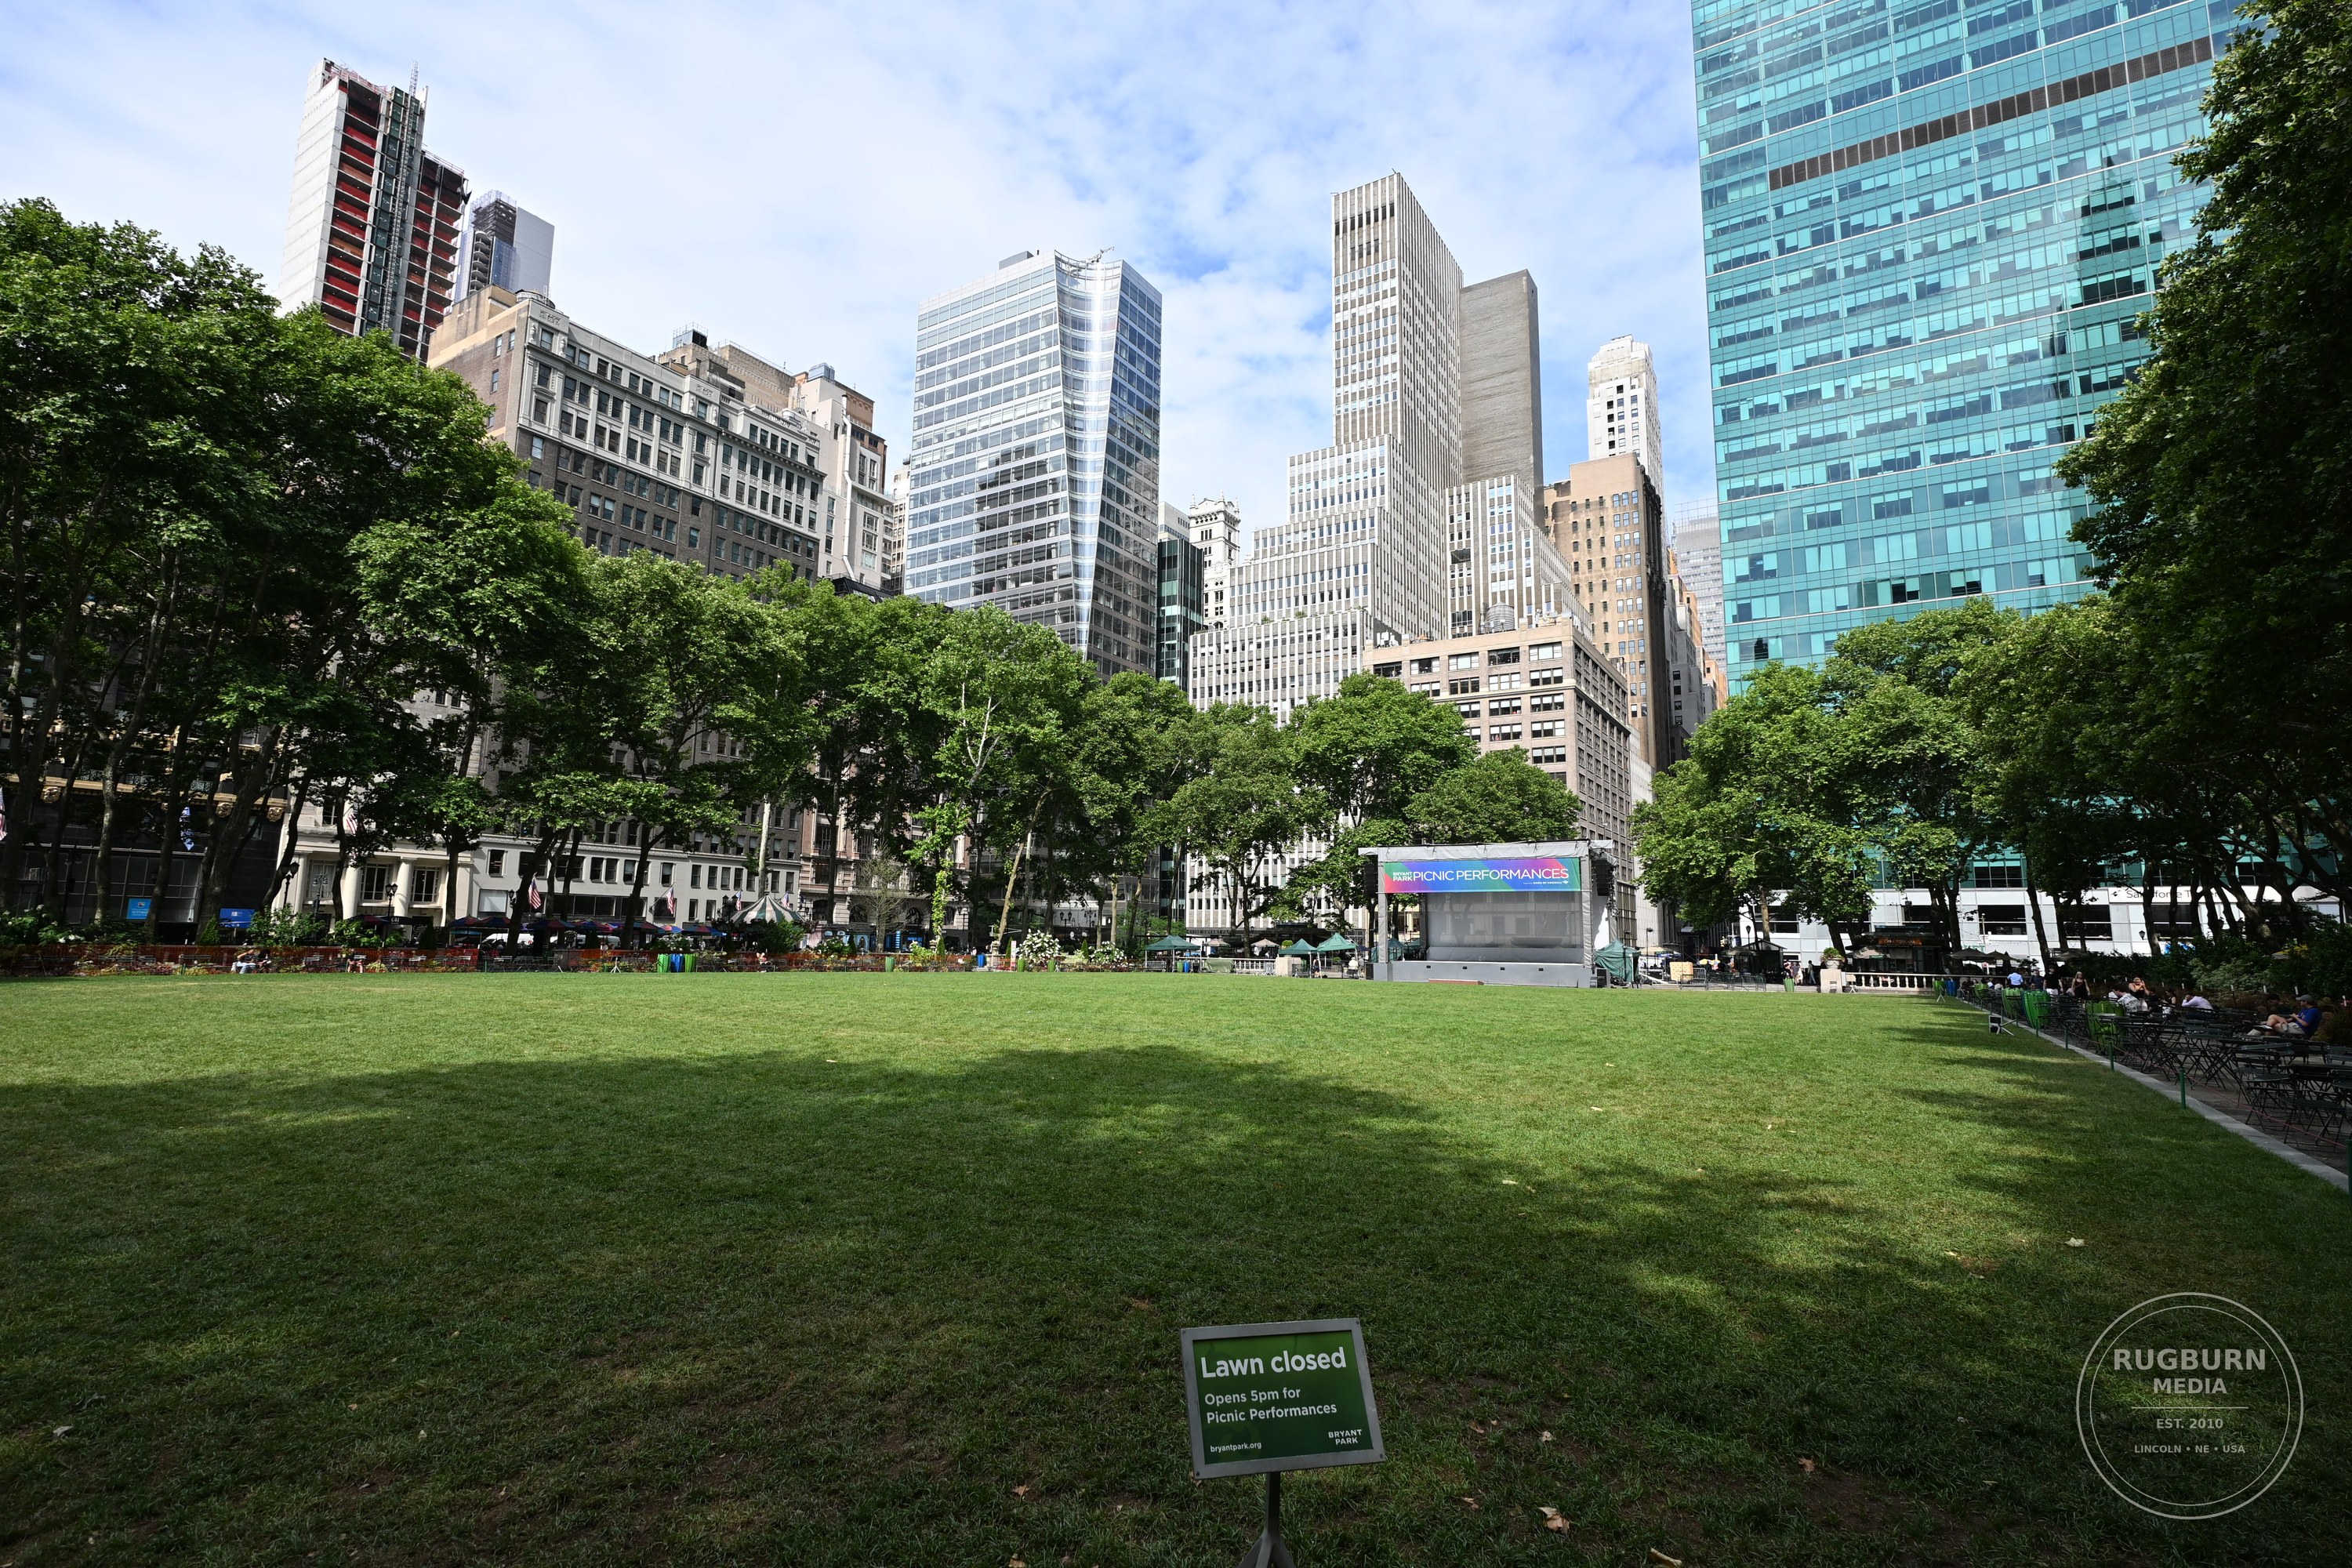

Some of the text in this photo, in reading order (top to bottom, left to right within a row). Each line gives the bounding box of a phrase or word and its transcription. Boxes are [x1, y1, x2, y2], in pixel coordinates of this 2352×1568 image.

[1413, 868, 1569, 881] PICNIC PERFORMANCES
[2126, 890, 2183, 898] Salfore
[1200, 1346, 1347, 1378] Lawn closed
[1204, 1387, 1301, 1406] Opens 5pm for
[1207, 1403, 1338, 1424] Picnic Performances
[1328, 1429, 1363, 1439] BRYANT
[1335, 1436, 1359, 1445] PARK
[1210, 1441, 1262, 1453] bryantpark.org
